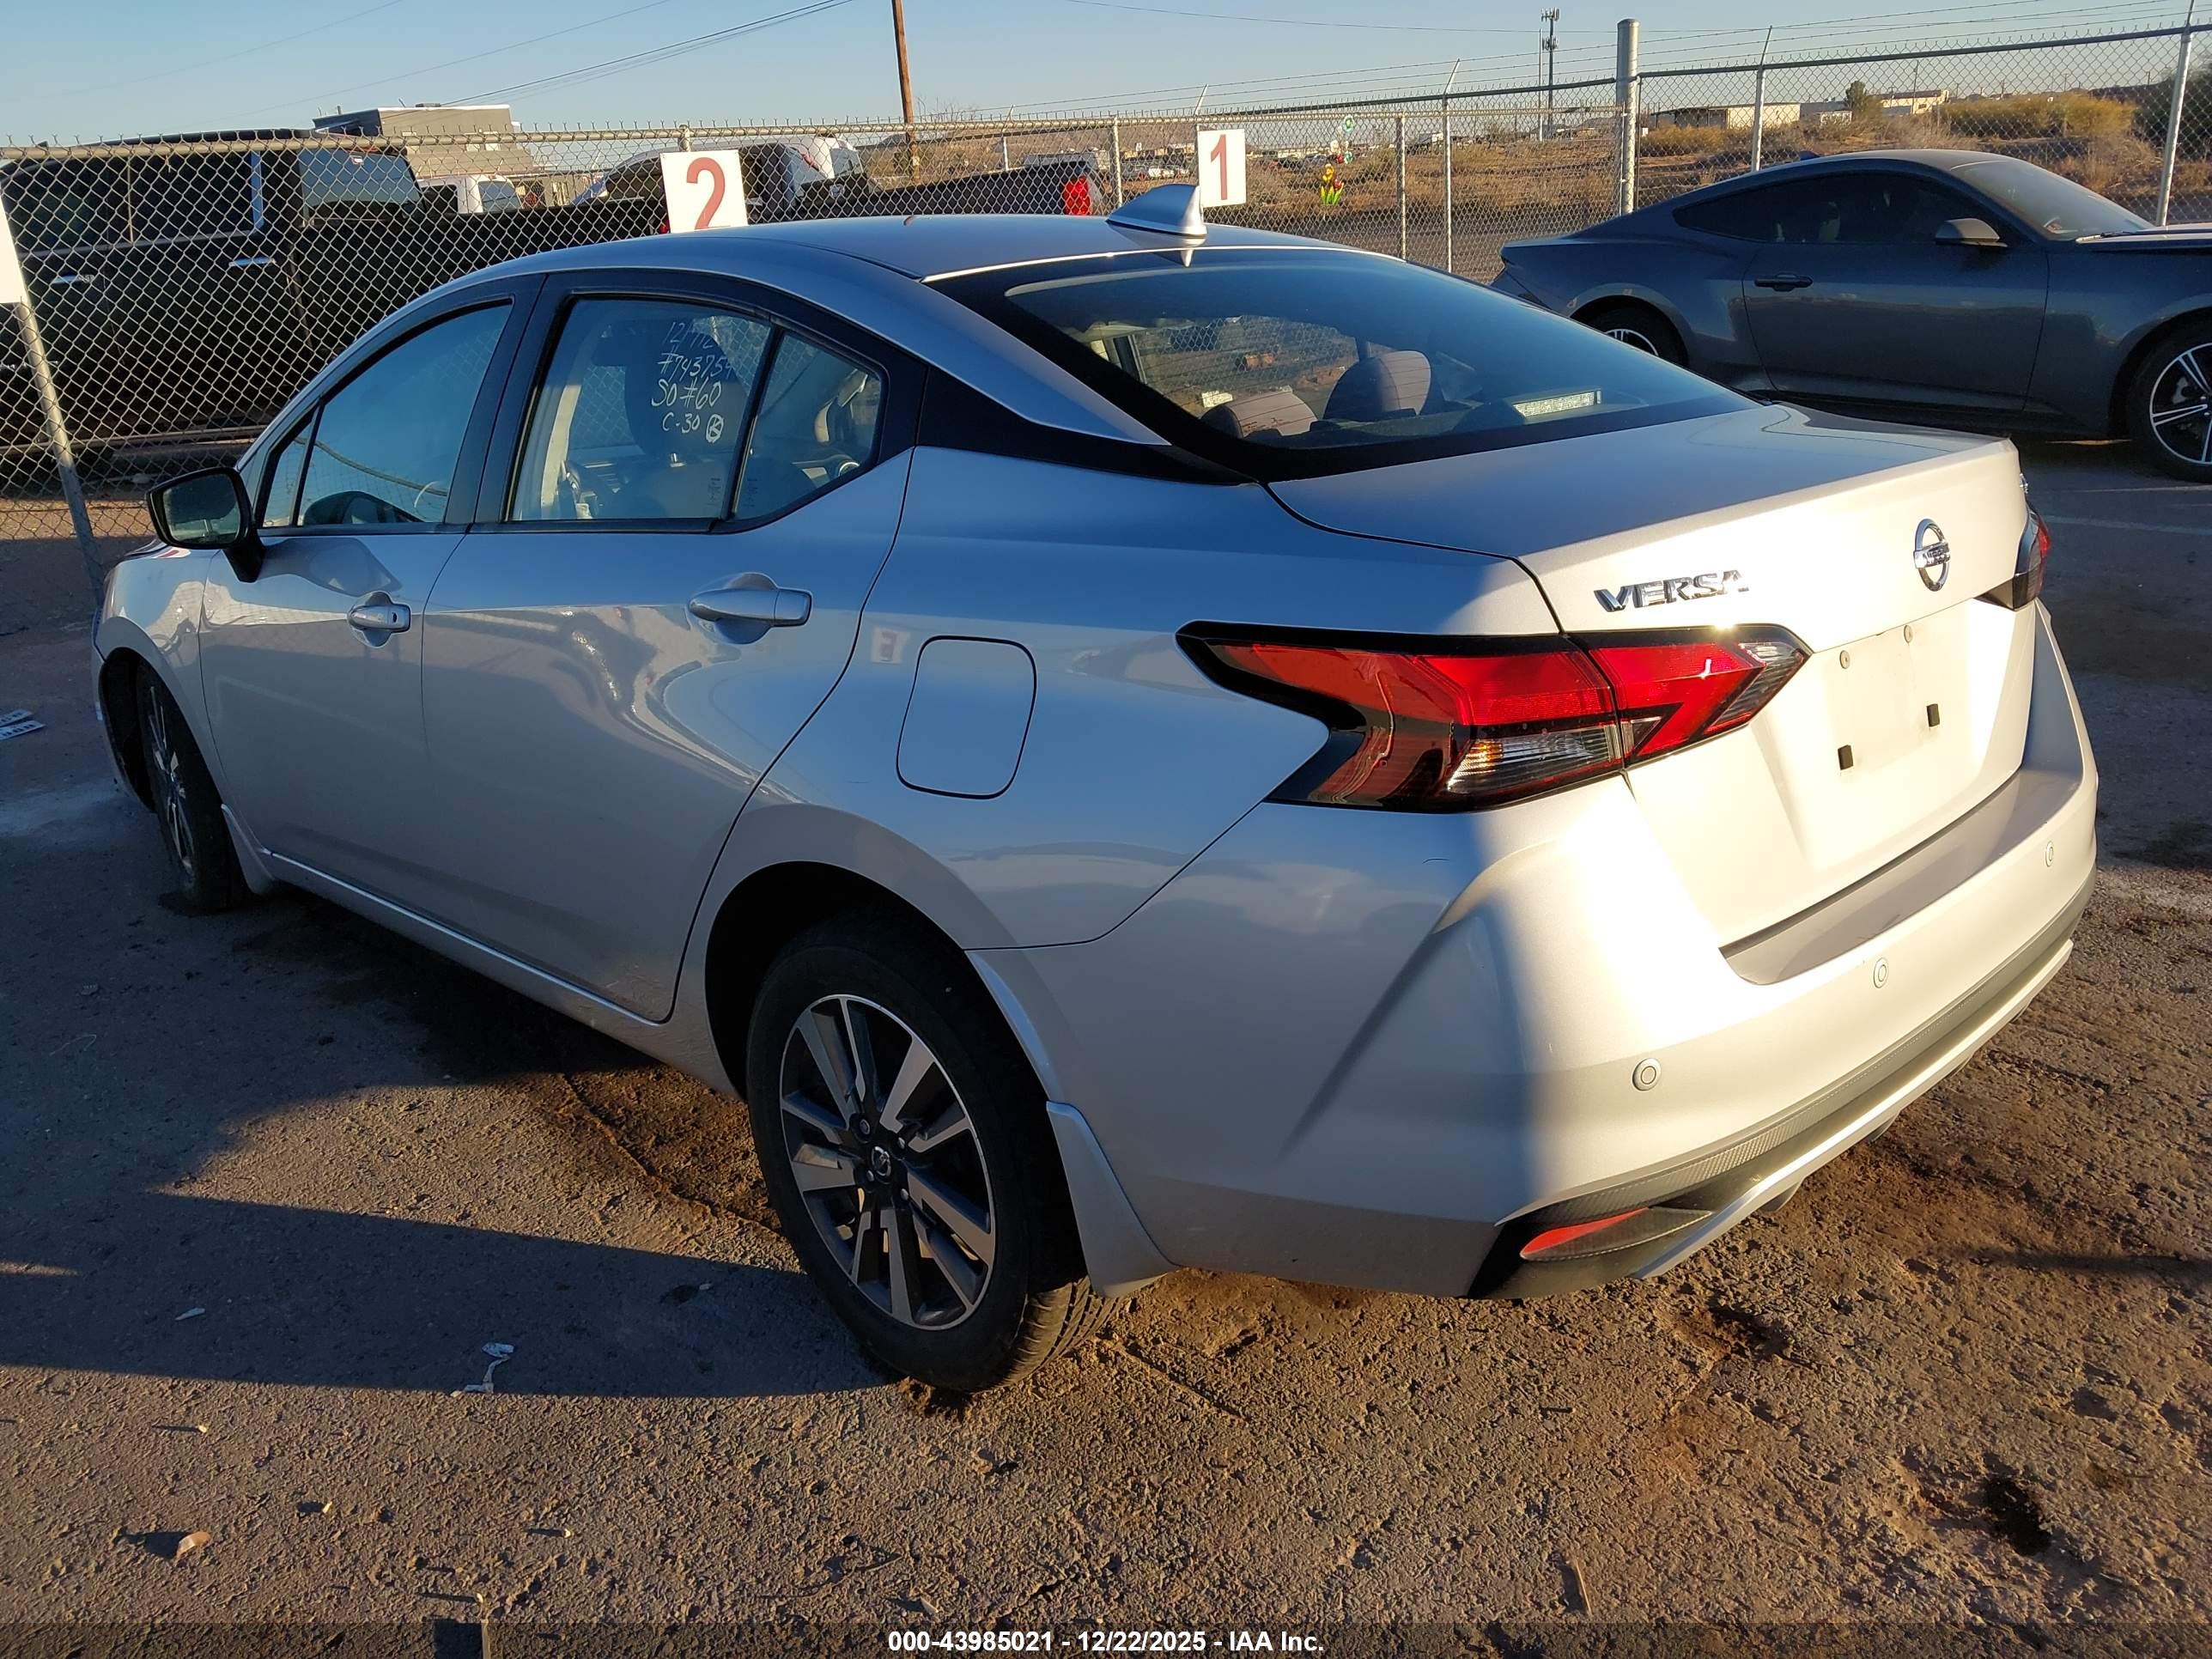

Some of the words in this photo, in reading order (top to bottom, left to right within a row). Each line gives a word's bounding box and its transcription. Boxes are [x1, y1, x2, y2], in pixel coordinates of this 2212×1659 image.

[686, 157, 731, 229] 2
[1210, 134, 1228, 200] 1
[1593, 570, 1749, 612] VERSA
